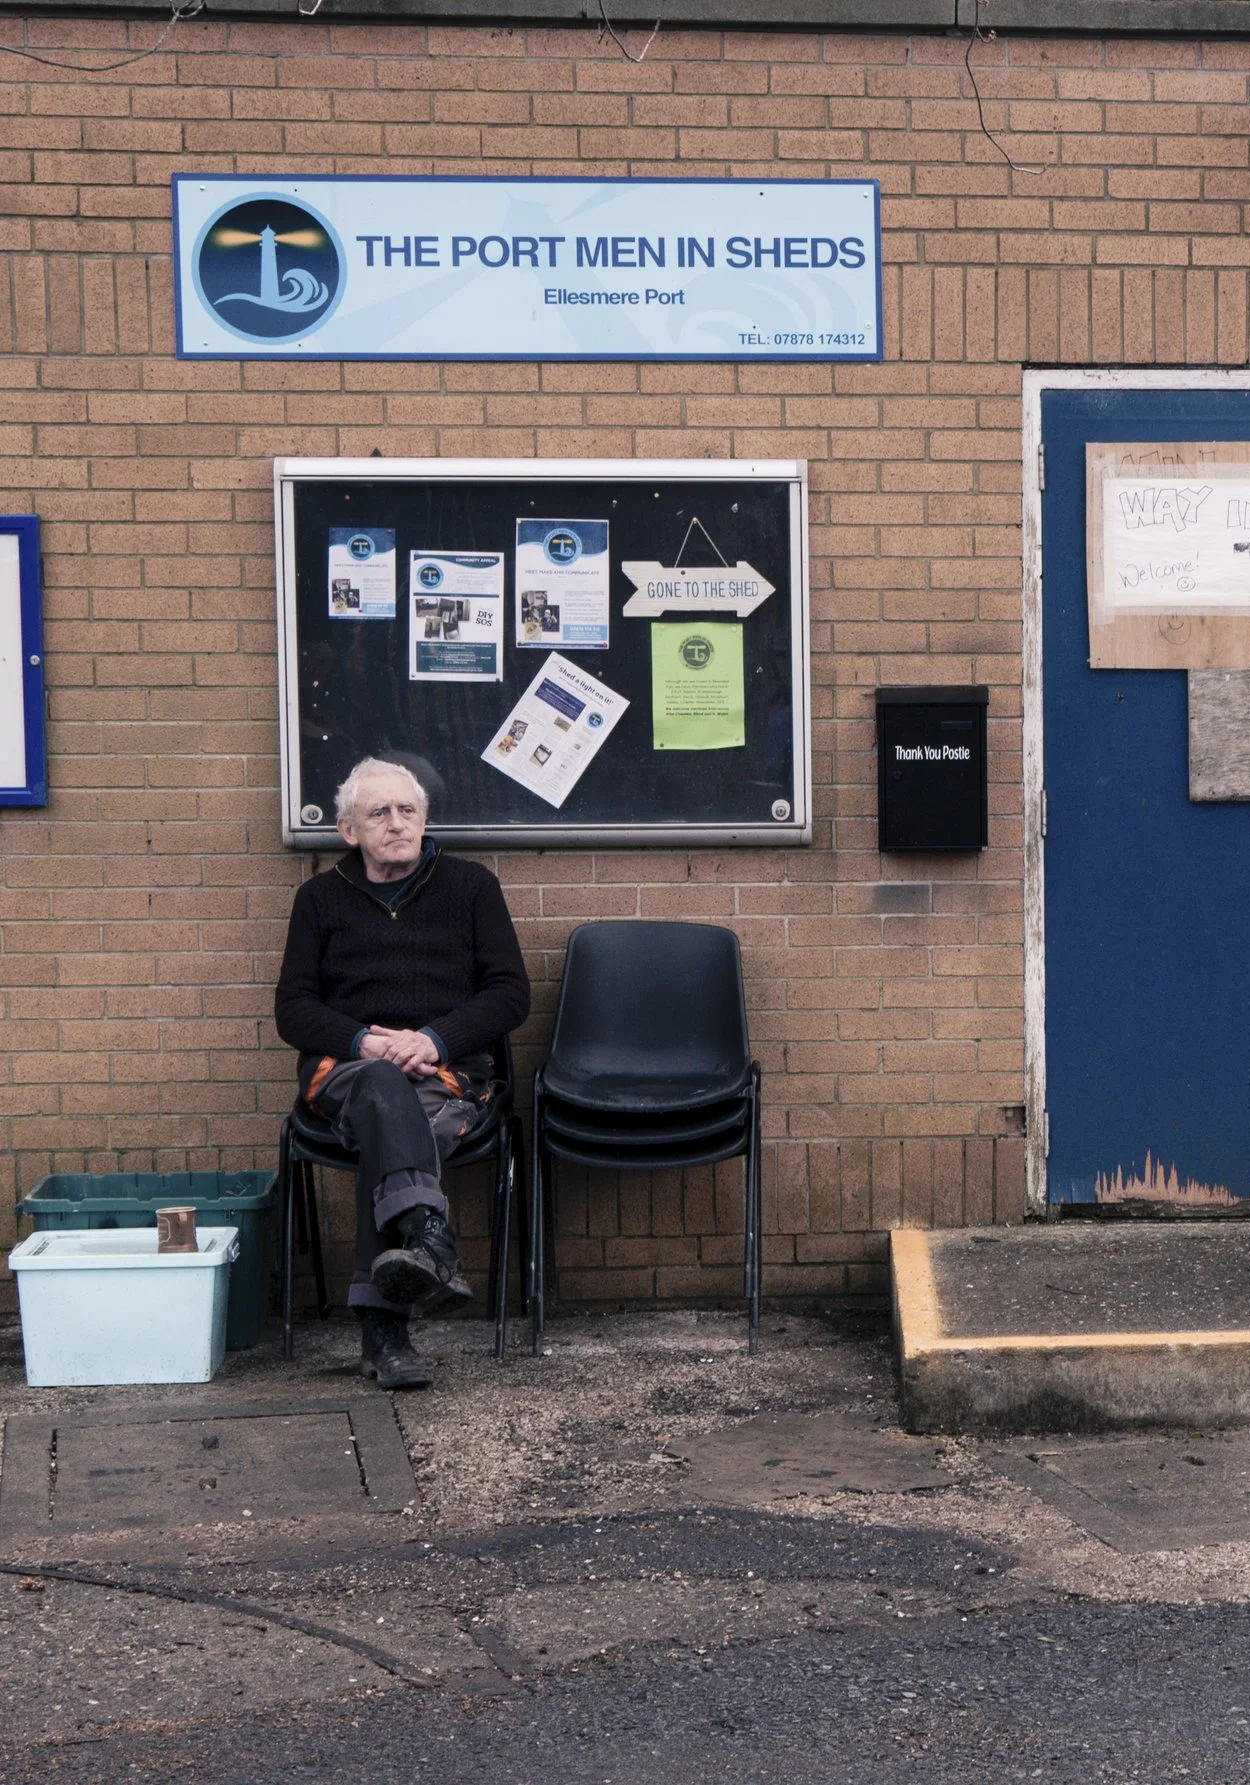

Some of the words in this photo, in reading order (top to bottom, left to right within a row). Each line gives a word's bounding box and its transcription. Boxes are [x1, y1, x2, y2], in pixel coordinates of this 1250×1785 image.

[356, 235, 441, 268] THE
[451, 235, 566, 268] PORT
[575, 236, 666, 268] MEN
[677, 236, 715, 268] IN
[726, 236, 866, 269] SHEDS
[544, 288, 640, 305] Ellesmere
[645, 288, 686, 305] Port
[738, 333, 770, 345] TEL:
[774, 333, 814, 345] 07878
[818, 333, 866, 345] 174312
[1118, 485, 1214, 533] WAY
[1118, 551, 1200, 588] Welcome!
[647, 581, 681, 598] GONE
[684, 581, 700, 598] TO
[703, 581, 726, 598] THE
[728, 581, 759, 598] SHED
[475, 617, 493, 627] SOS
[477, 610, 494, 620] DIY
[579, 680, 596, 694] light
[595, 691, 604, 701] on
[895, 745, 924, 760] Thank
[924, 745, 941, 760] You
[942, 745, 971, 760] Postie
